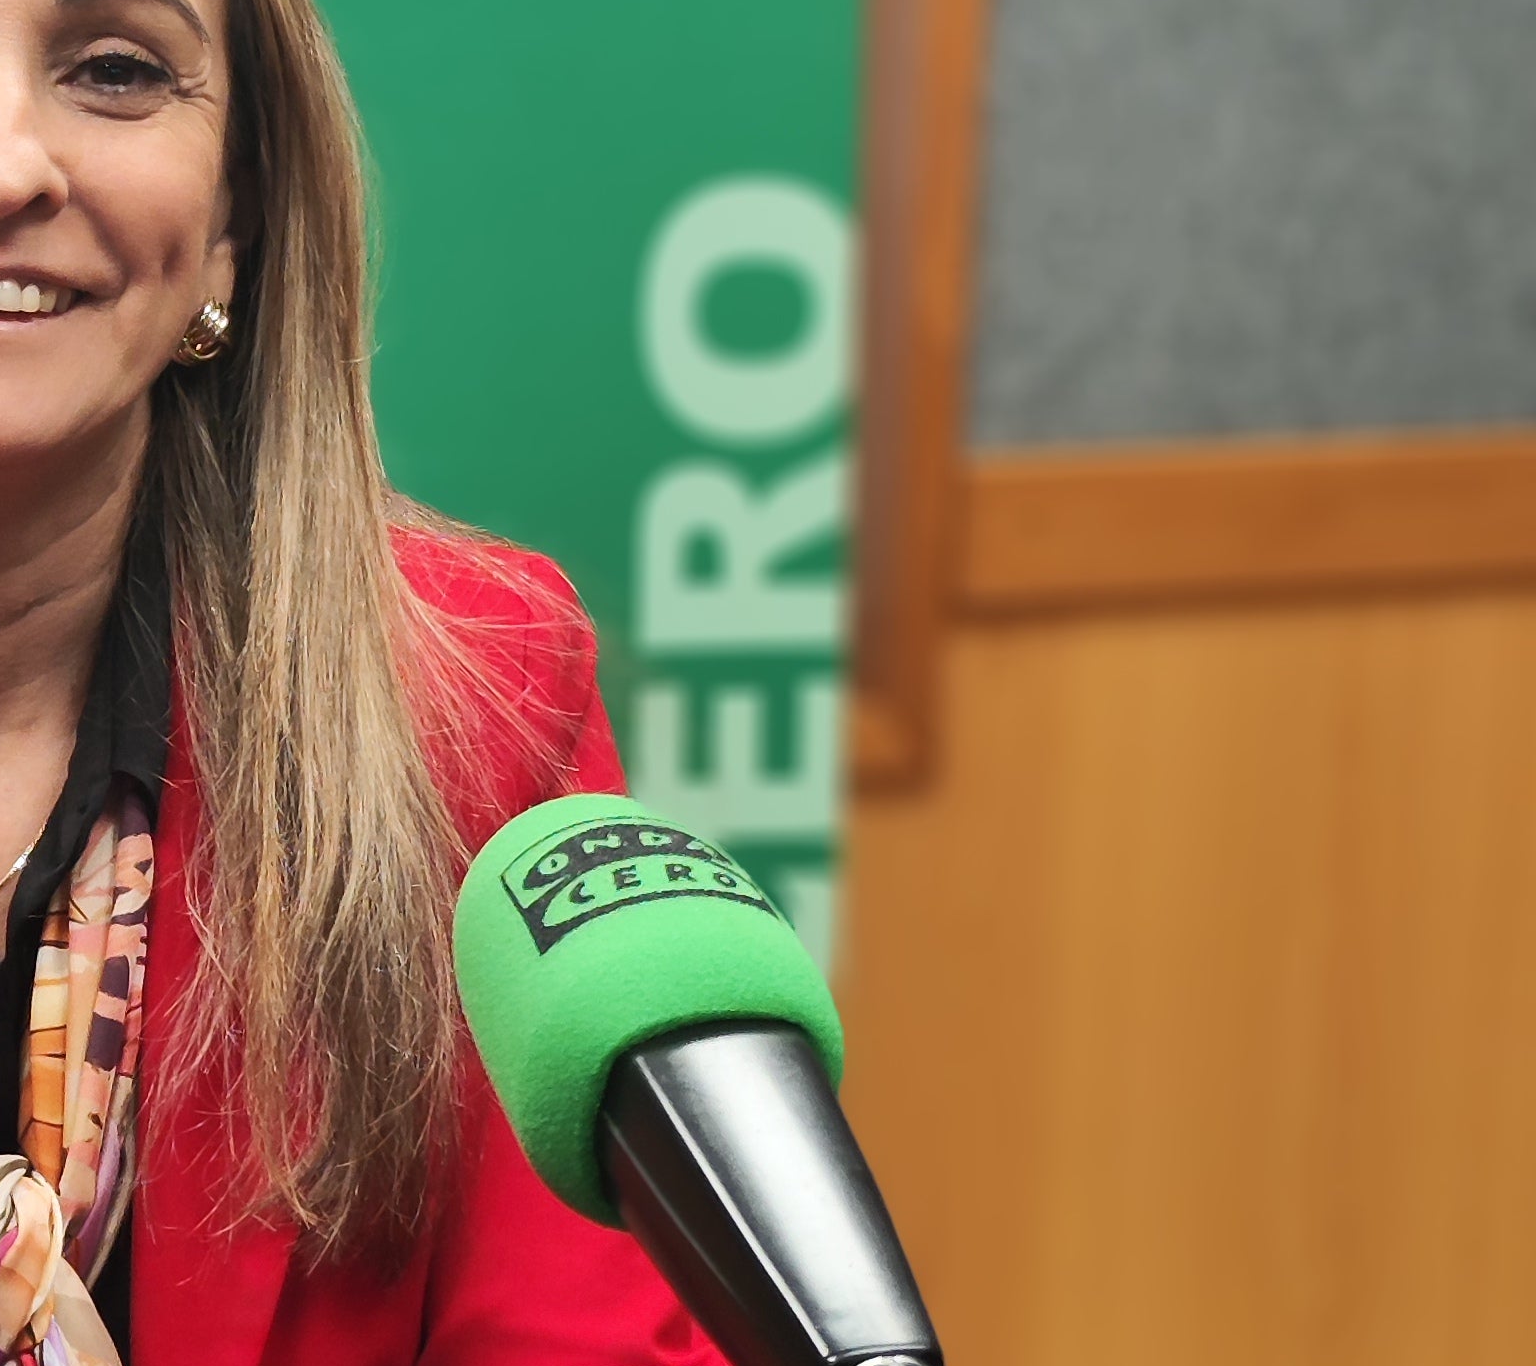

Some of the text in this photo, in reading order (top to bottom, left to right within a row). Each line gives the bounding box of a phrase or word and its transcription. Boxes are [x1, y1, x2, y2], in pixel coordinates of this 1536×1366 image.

[632, 173, 859, 980] ERO
[537, 831, 732, 875] ONDA
[568, 863, 739, 905] CERO
